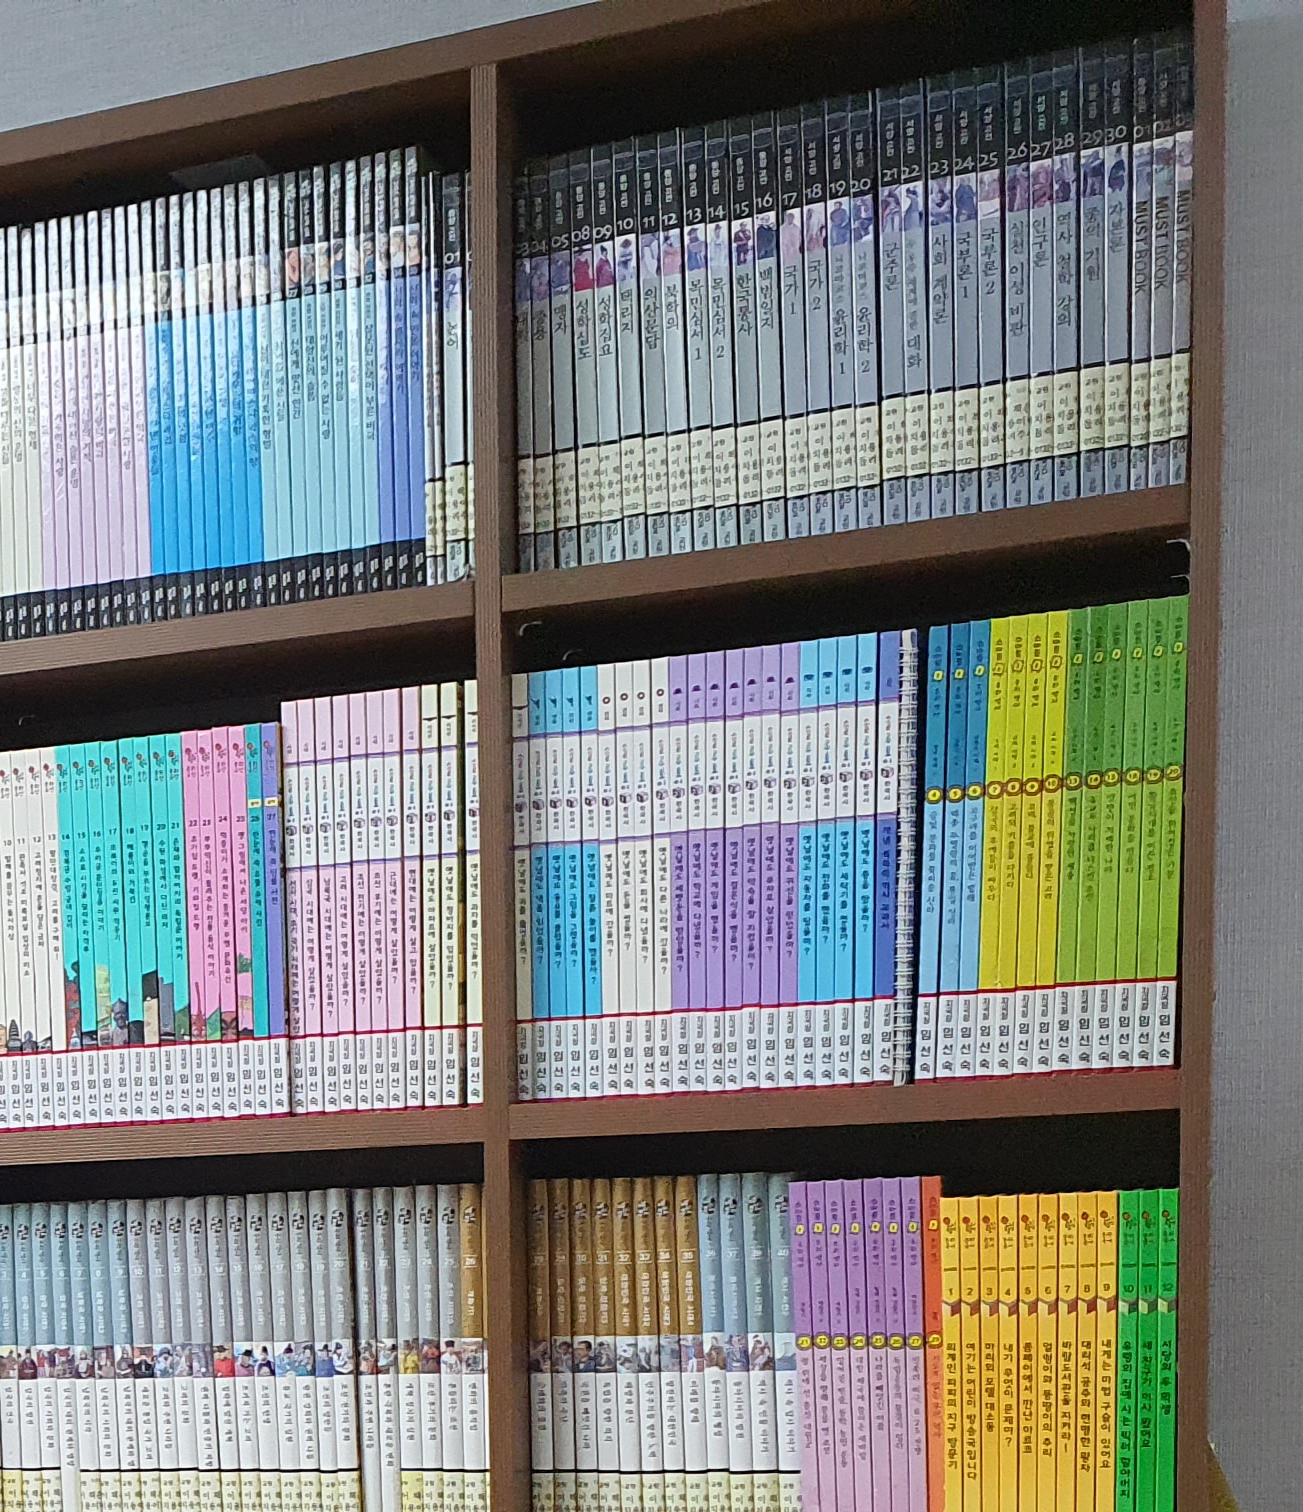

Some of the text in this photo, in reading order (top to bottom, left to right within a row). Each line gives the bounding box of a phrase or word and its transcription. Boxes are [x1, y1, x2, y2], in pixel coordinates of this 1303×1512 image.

[1054, 133, 1075, 149] 28
[1083, 130, 1103, 145] 29
[1106, 126, 1127, 143] 30
[1007, 143, 1028, 159] 26
[1030, 141, 1051, 157] 27
[954, 155, 974, 171] 24
[978, 152, 998, 166] 25
[901, 164, 920, 179] 22
[930, 160, 949, 174] 23
[882, 168, 899, 181] 21
[850, 179, 871, 193] 20
[643, 216, 655, 227] 11
[662, 213, 678, 226] 12
[686, 208, 702, 222] 13
[617, 218, 634, 231] 10
[572, 226, 590, 242] 08
[594, 225, 612, 239] 09
[551, 233, 569, 249] 05
[1135, 200, 1150, 294] MUST BOOK
[1154, 196, 1170, 290] MUST BOOK
[1176, 239, 1190, 283] BOOK
[985, 282, 995, 295] 2
[812, 297, 821, 310] 2
[716, 346, 725, 358] 2
[861, 360, 871, 373] 2
